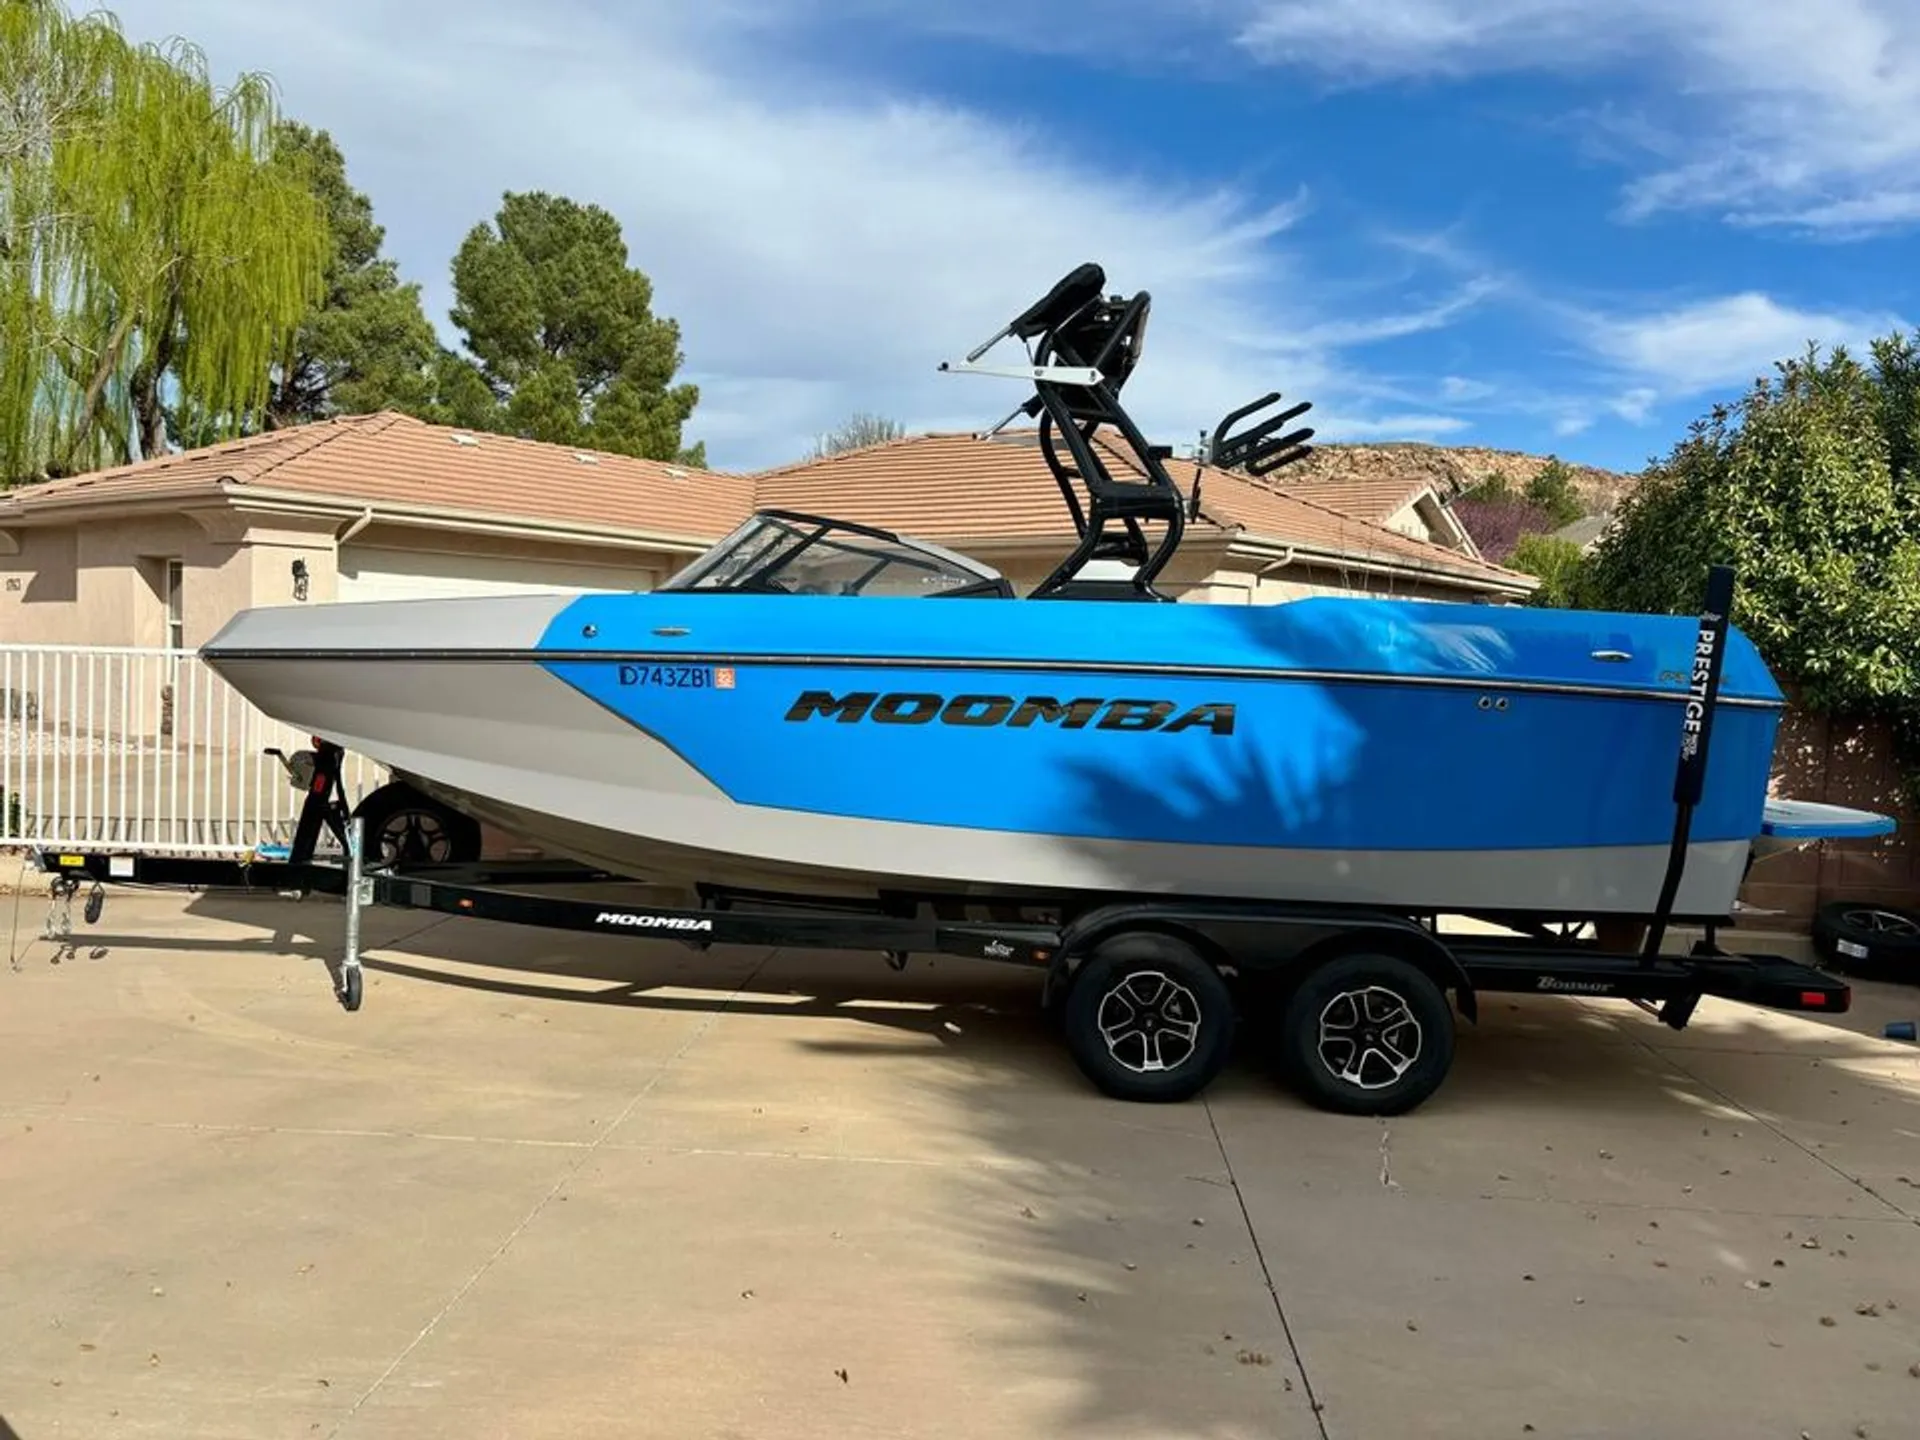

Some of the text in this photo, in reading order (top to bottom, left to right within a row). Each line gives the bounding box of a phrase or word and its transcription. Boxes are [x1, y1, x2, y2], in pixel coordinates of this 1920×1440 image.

[1683, 629, 1716, 733] PRESTIGE
[784, 690, 1236, 736] MOOMBA
[595, 912, 712, 931] MOOMBA
